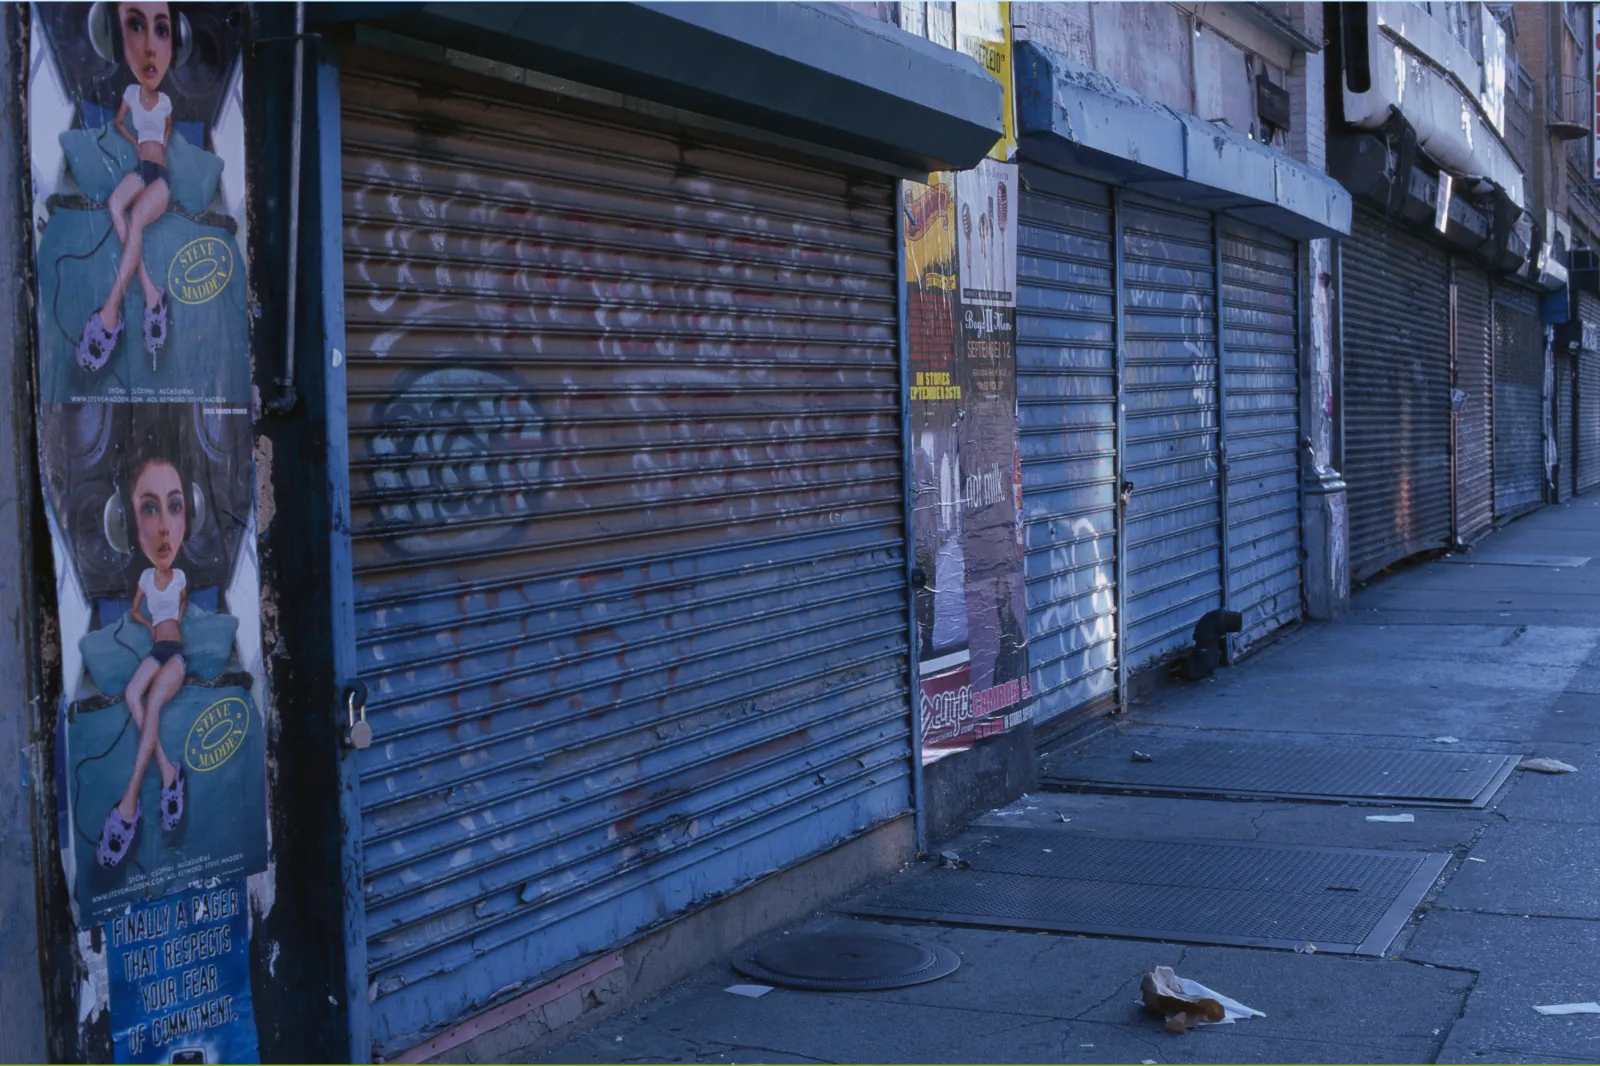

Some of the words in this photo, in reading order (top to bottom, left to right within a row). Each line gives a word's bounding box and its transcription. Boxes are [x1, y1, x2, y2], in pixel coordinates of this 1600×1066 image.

[179, 242, 217, 269] STEVE
[182, 266, 228, 300] MADDEN
[985, 308, 994, 333] II
[993, 311, 1013, 331] Men
[1002, 341, 1011, 358] 12
[910, 386, 944, 400] EPTEMBER
[916, 371, 924, 386] IN
[925, 371, 950, 386] STORES
[196, 703, 231, 737] STEVE
[199, 723, 244, 767] MADDEN
[112, 904, 170, 948] FINALLY
[174, 899, 188, 930] A
[191, 887, 240, 925] PAGER
[122, 944, 158, 983] THAT
[164, 924, 232, 971] RESPECTS
[141, 976, 178, 1014] YOUR
[182, 963, 218, 1000] FEAR
[128, 1022, 147, 1056] OF
[152, 994, 239, 1048] COMMITMENT.
